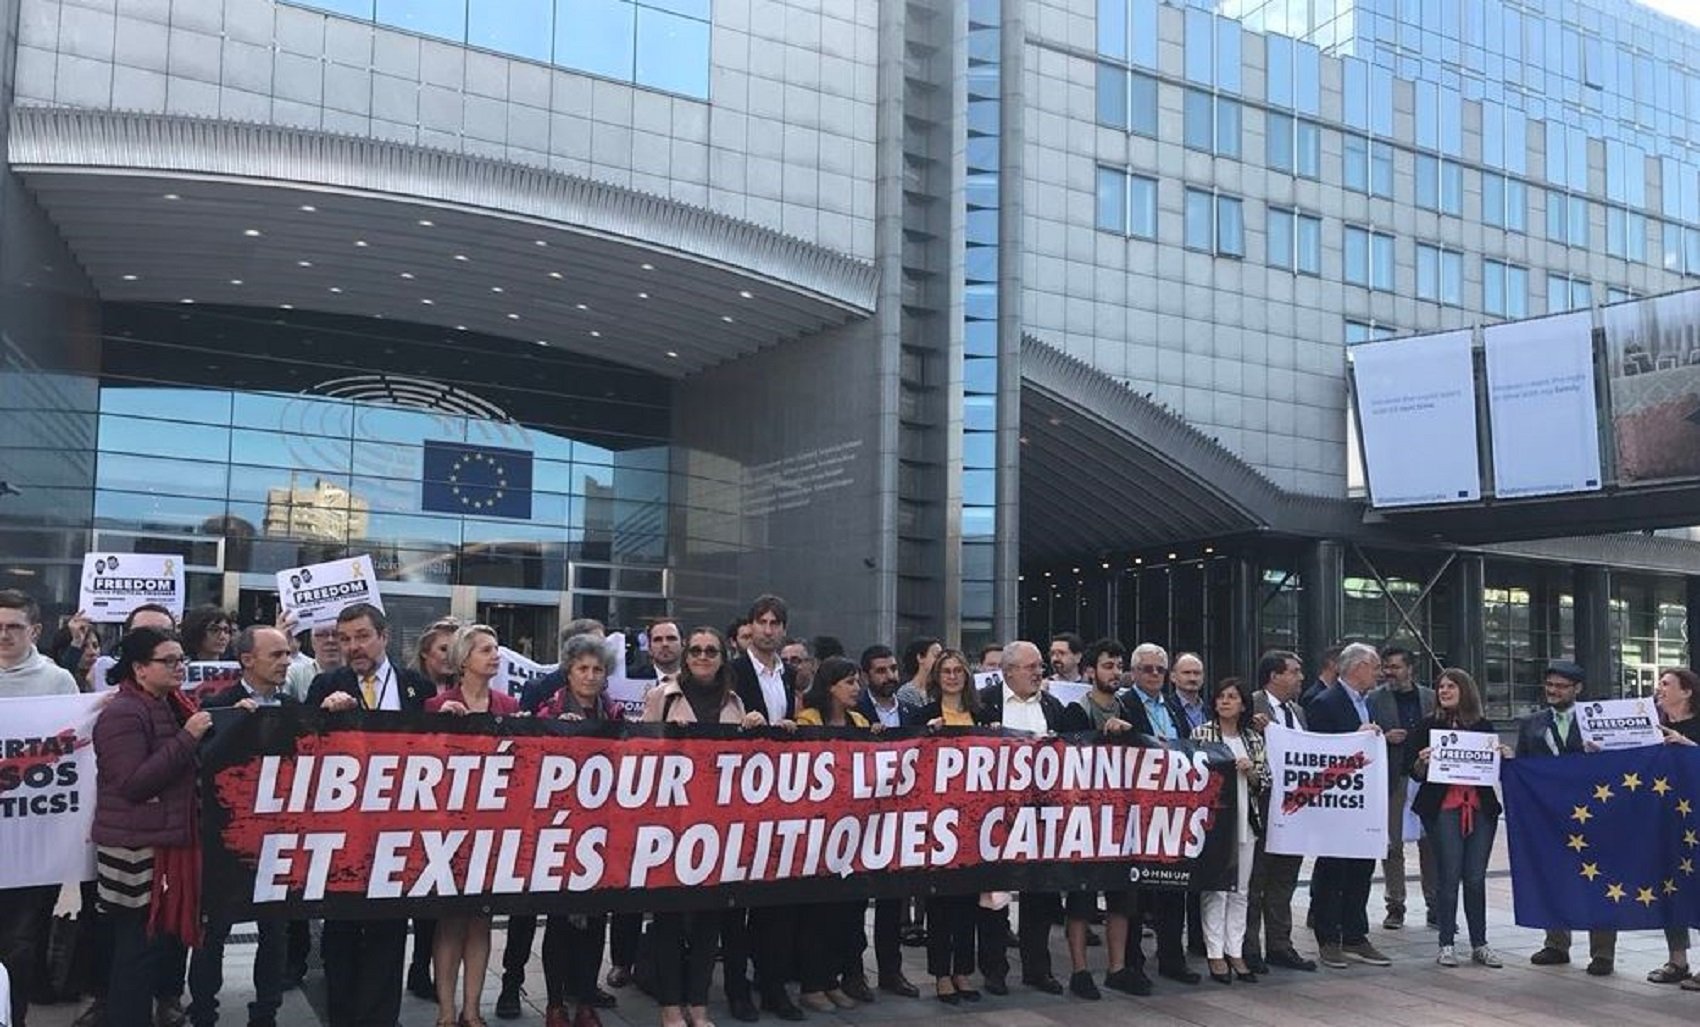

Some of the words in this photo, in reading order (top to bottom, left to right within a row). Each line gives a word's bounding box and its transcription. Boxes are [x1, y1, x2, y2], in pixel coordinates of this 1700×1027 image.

[96, 579, 171, 591] FREEDOM
[296, 581, 364, 603] FREEDOM
[1589, 718, 1647, 729] FREEDOM
[1441, 750, 1491, 761] FREEDOM
[254, 740, 514, 813] LIBERTÉ
[534, 755, 694, 809] POUR
[717, 751, 835, 806] TOUS
[853, 748, 920, 799] LES
[934, 745, 1209, 794] PRISONNIERS
[1284, 769, 1364, 791] PRESOS
[1283, 791, 1364, 809] POLITICS!
[253, 832, 346, 903] ET
[366, 810, 608, 899] EXILÉS
[629, 807, 959, 888] POLITIQUES
[979, 804, 1209, 862] CATALANS
